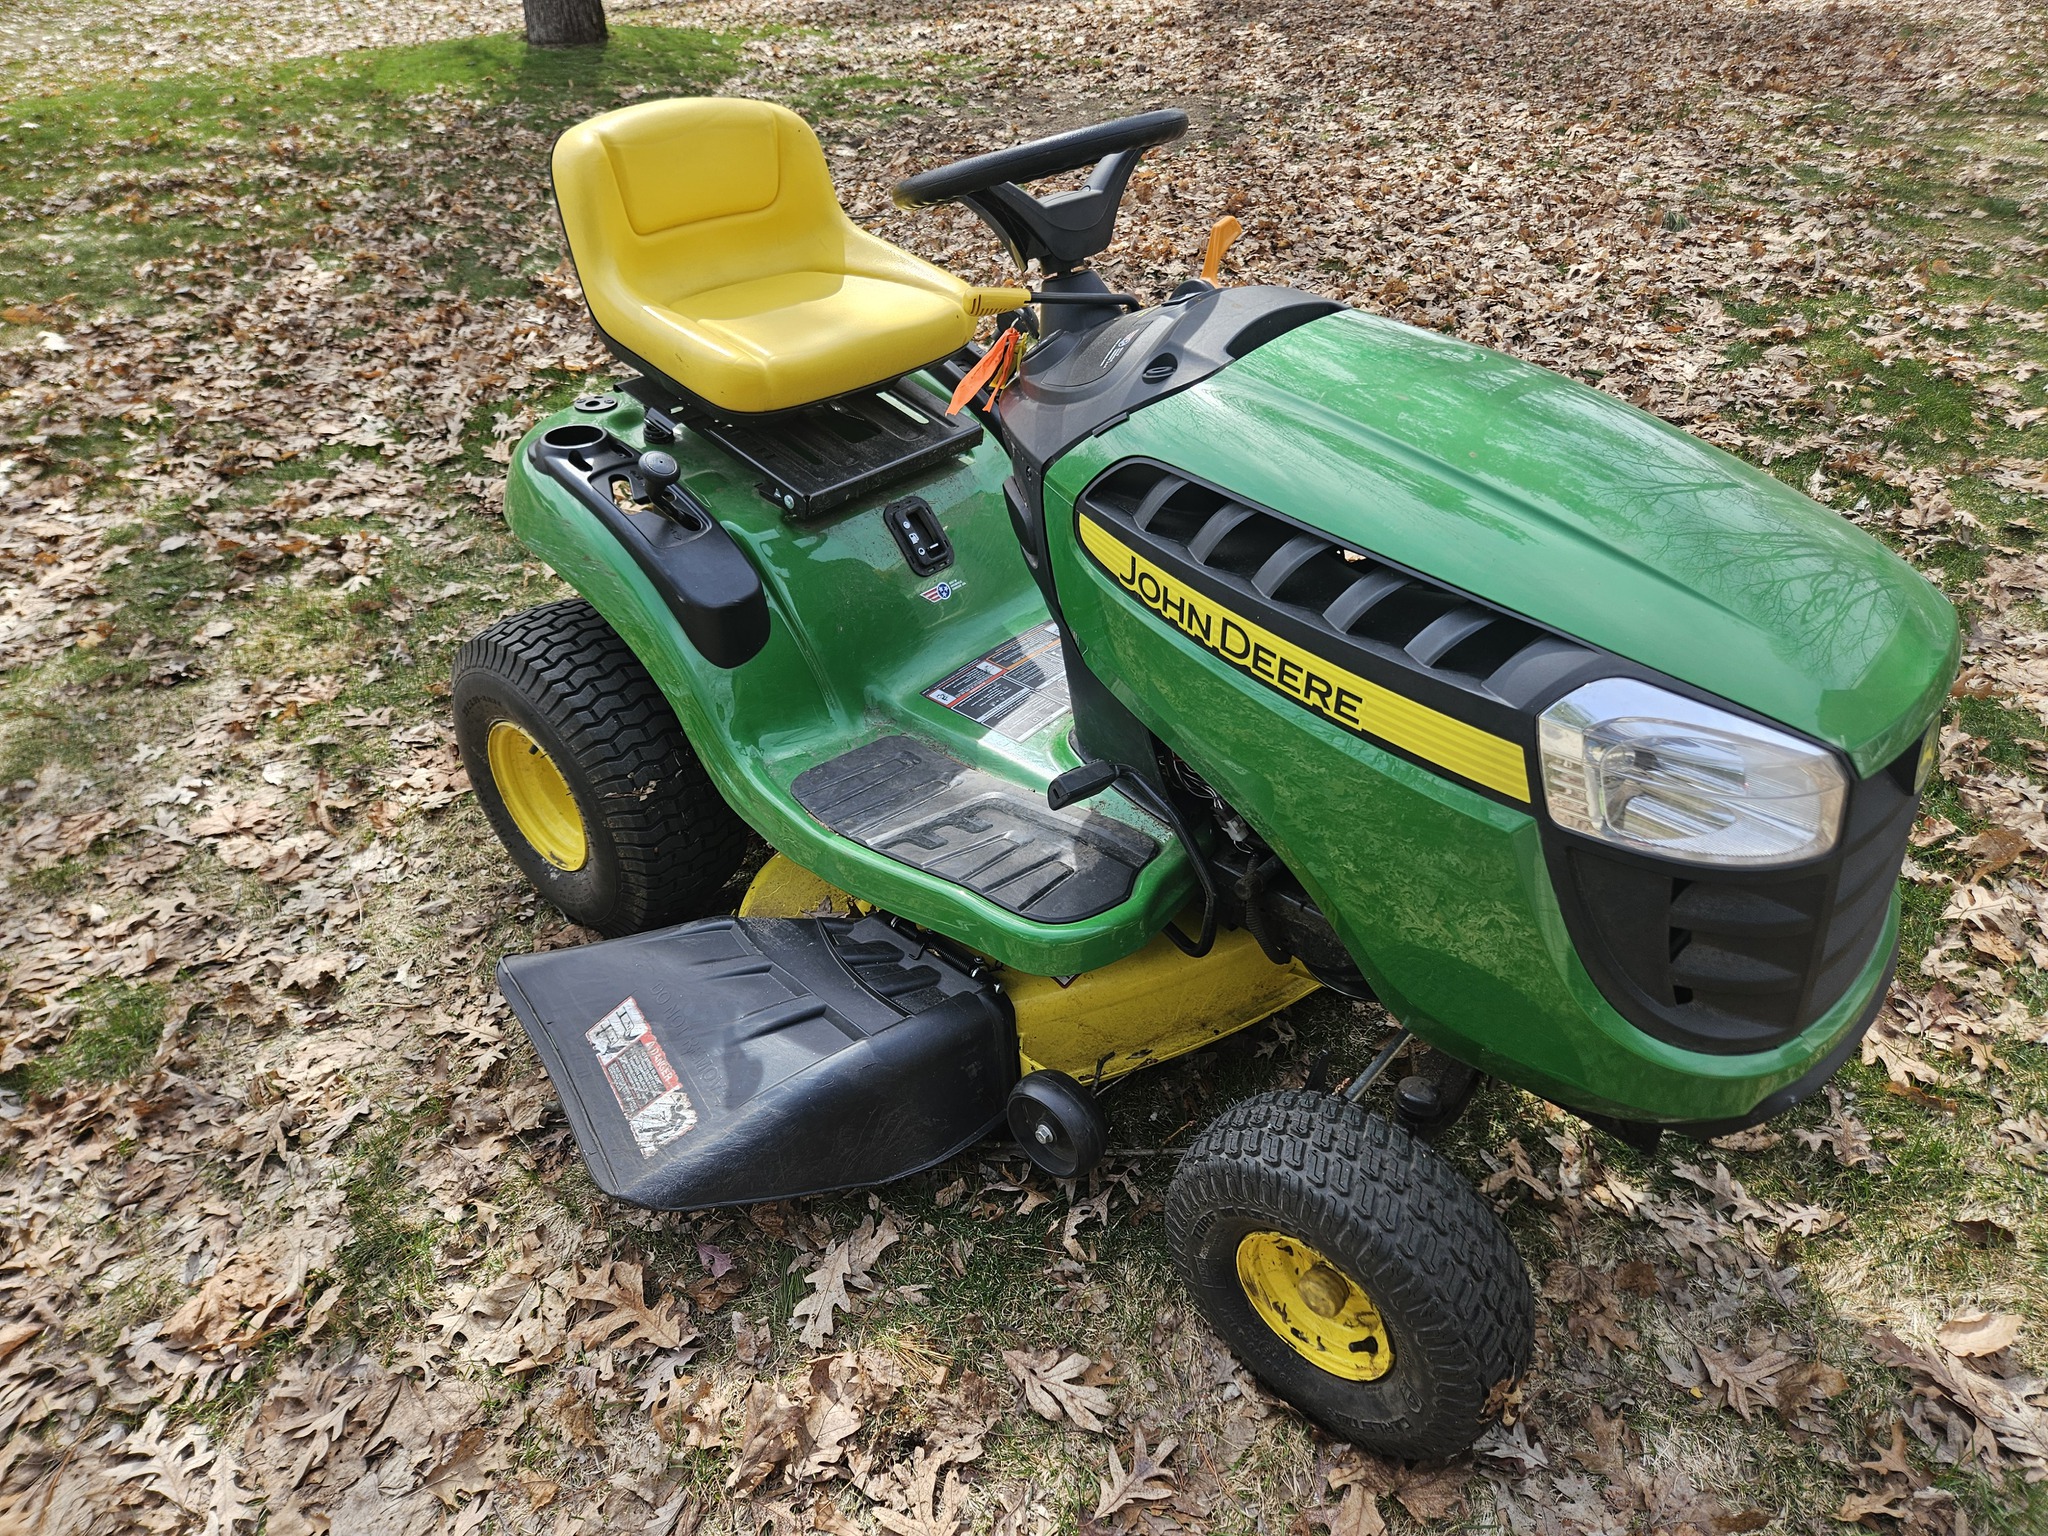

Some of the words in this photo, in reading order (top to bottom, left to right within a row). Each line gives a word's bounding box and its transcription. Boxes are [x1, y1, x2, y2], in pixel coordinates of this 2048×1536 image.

[1118, 556, 1212, 643] JOHN
[1221, 620, 1363, 725] DEERE
[650, 981, 672, 1006] DO
[665, 1003, 690, 1037] NOT
[681, 1037, 728, 1106] REMOVE
[650, 1047, 674, 1082] DANGER
[1190, 1209, 1219, 1240] TURF
